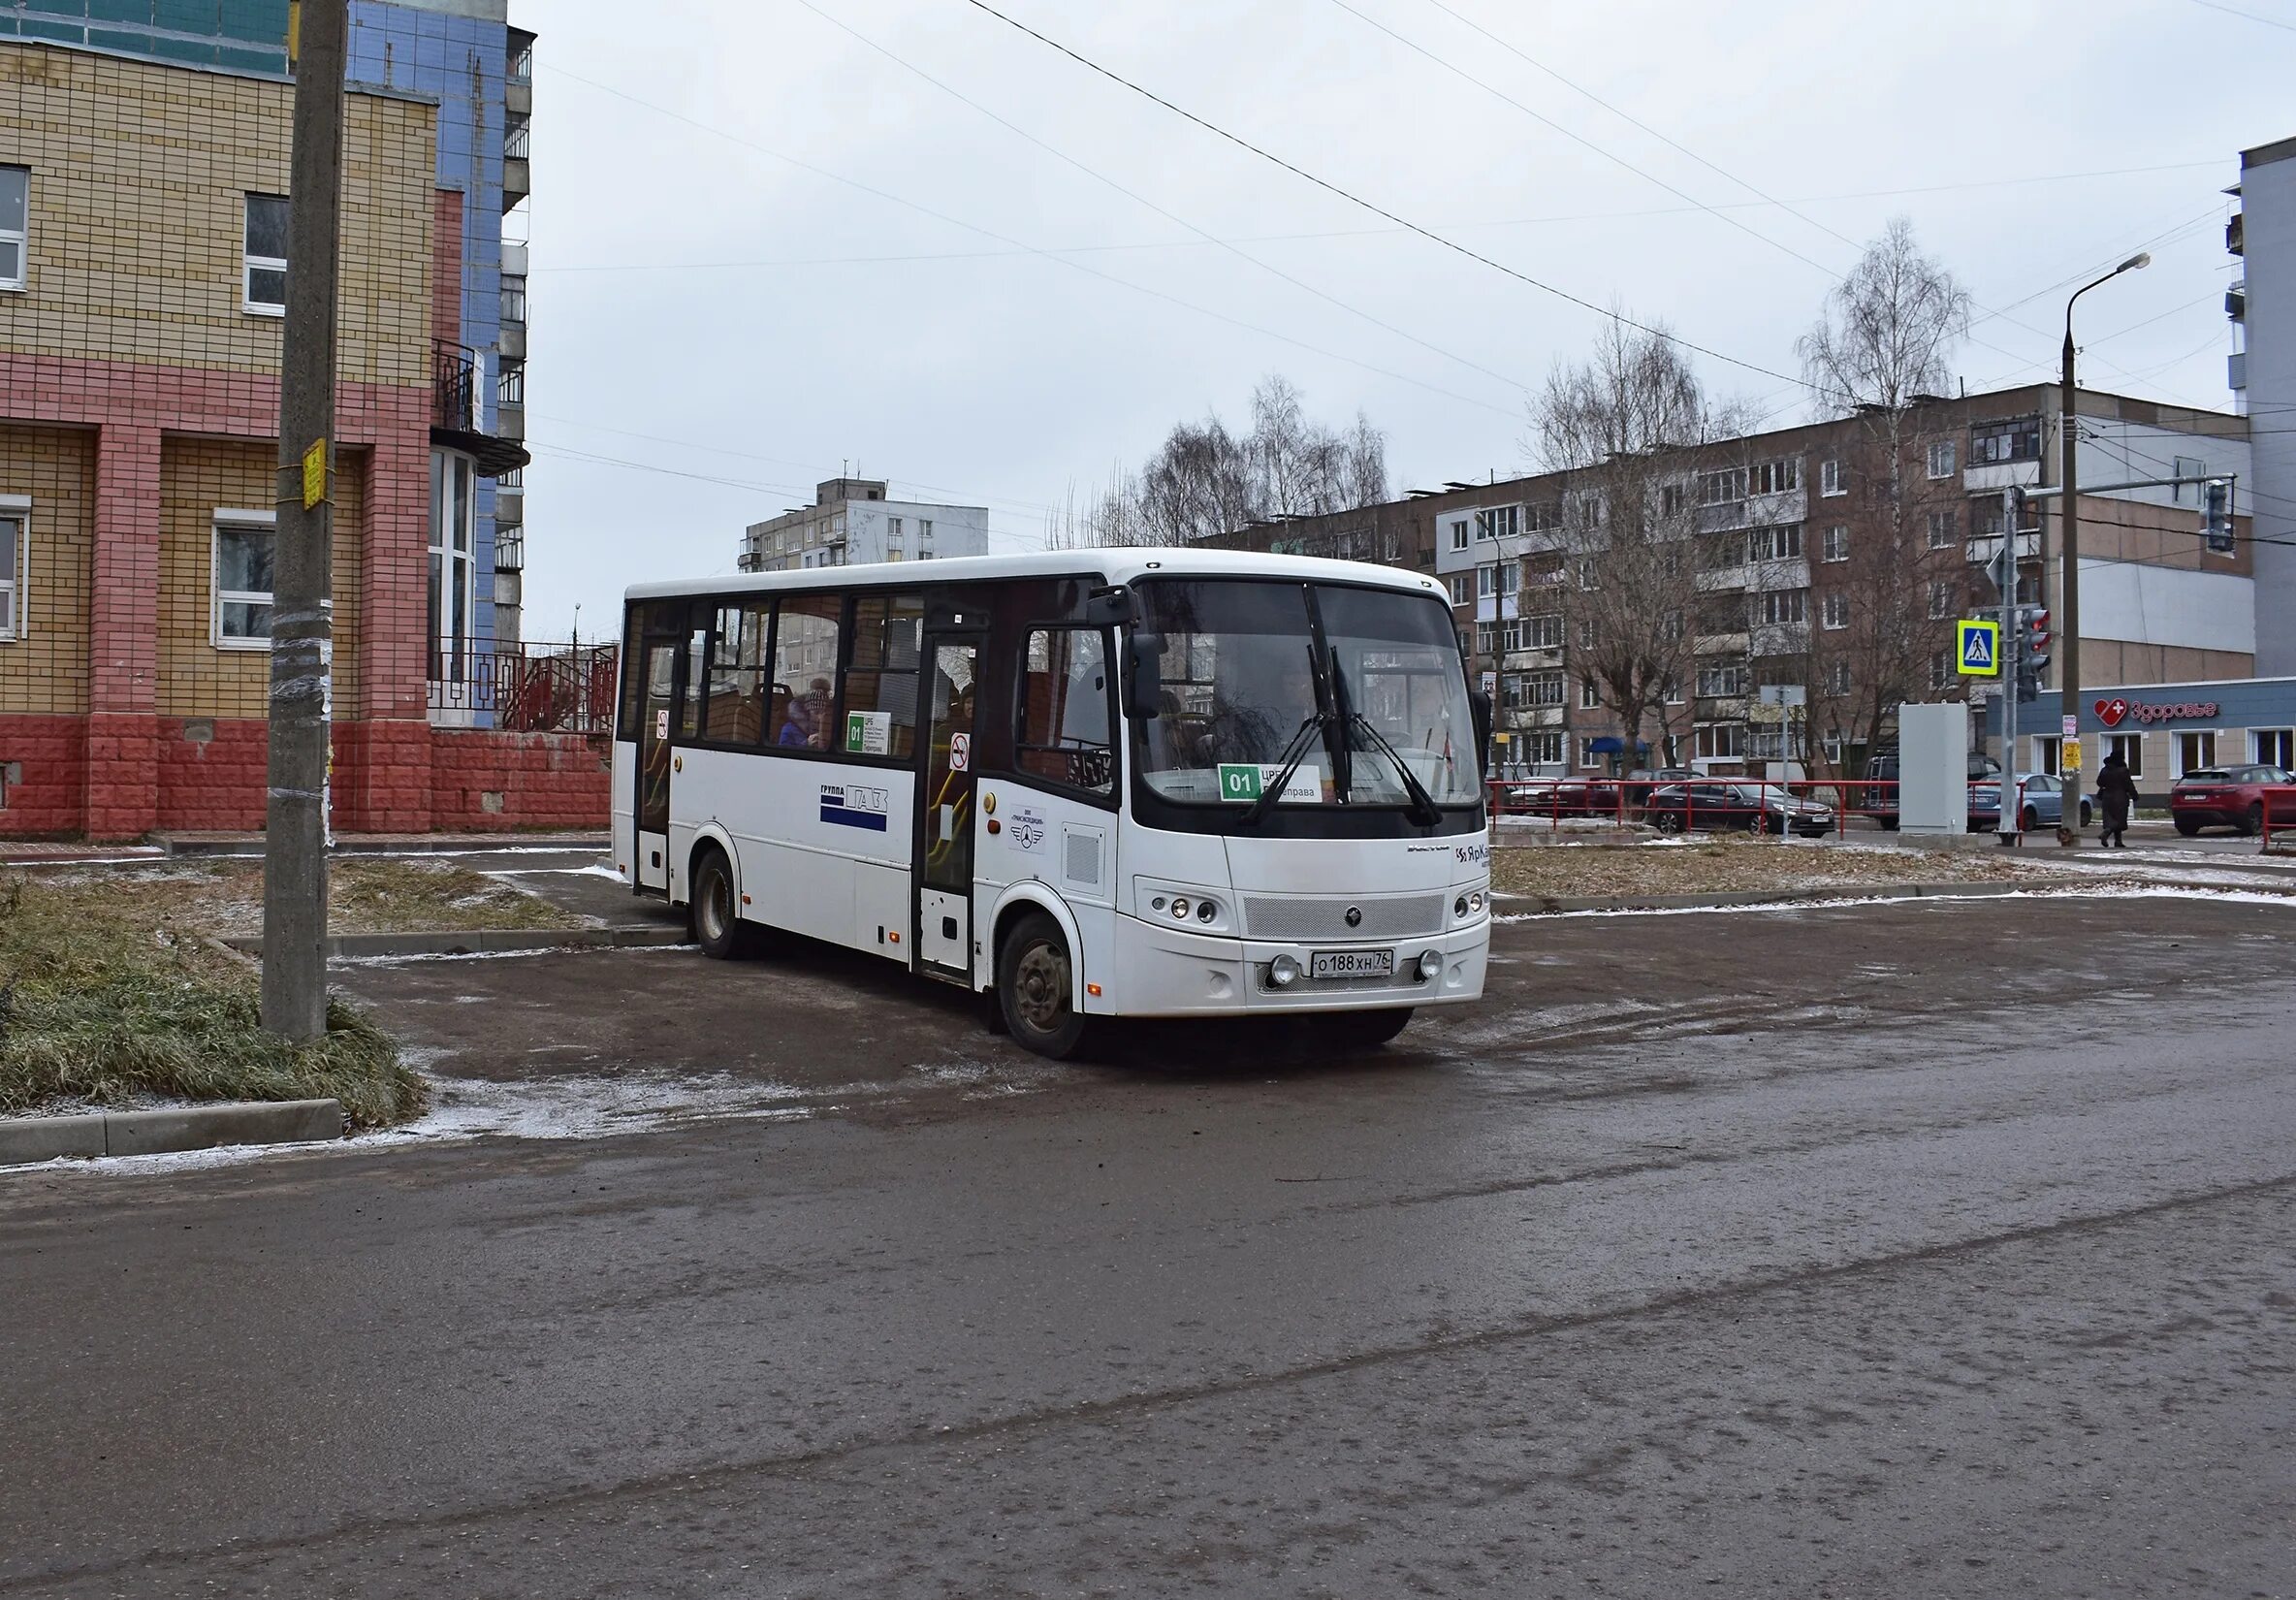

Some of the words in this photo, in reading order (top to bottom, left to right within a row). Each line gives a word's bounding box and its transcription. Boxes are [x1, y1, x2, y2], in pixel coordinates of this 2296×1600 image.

[2131, 700, 2216, 723] Здоровье
[851, 725, 861, 742] 01
[1229, 774, 1251, 792] 01
[820, 784, 845, 795] ГРУППА
[846, 784, 888, 813] ГАЗ
[1376, 953, 1387, 965] 76
